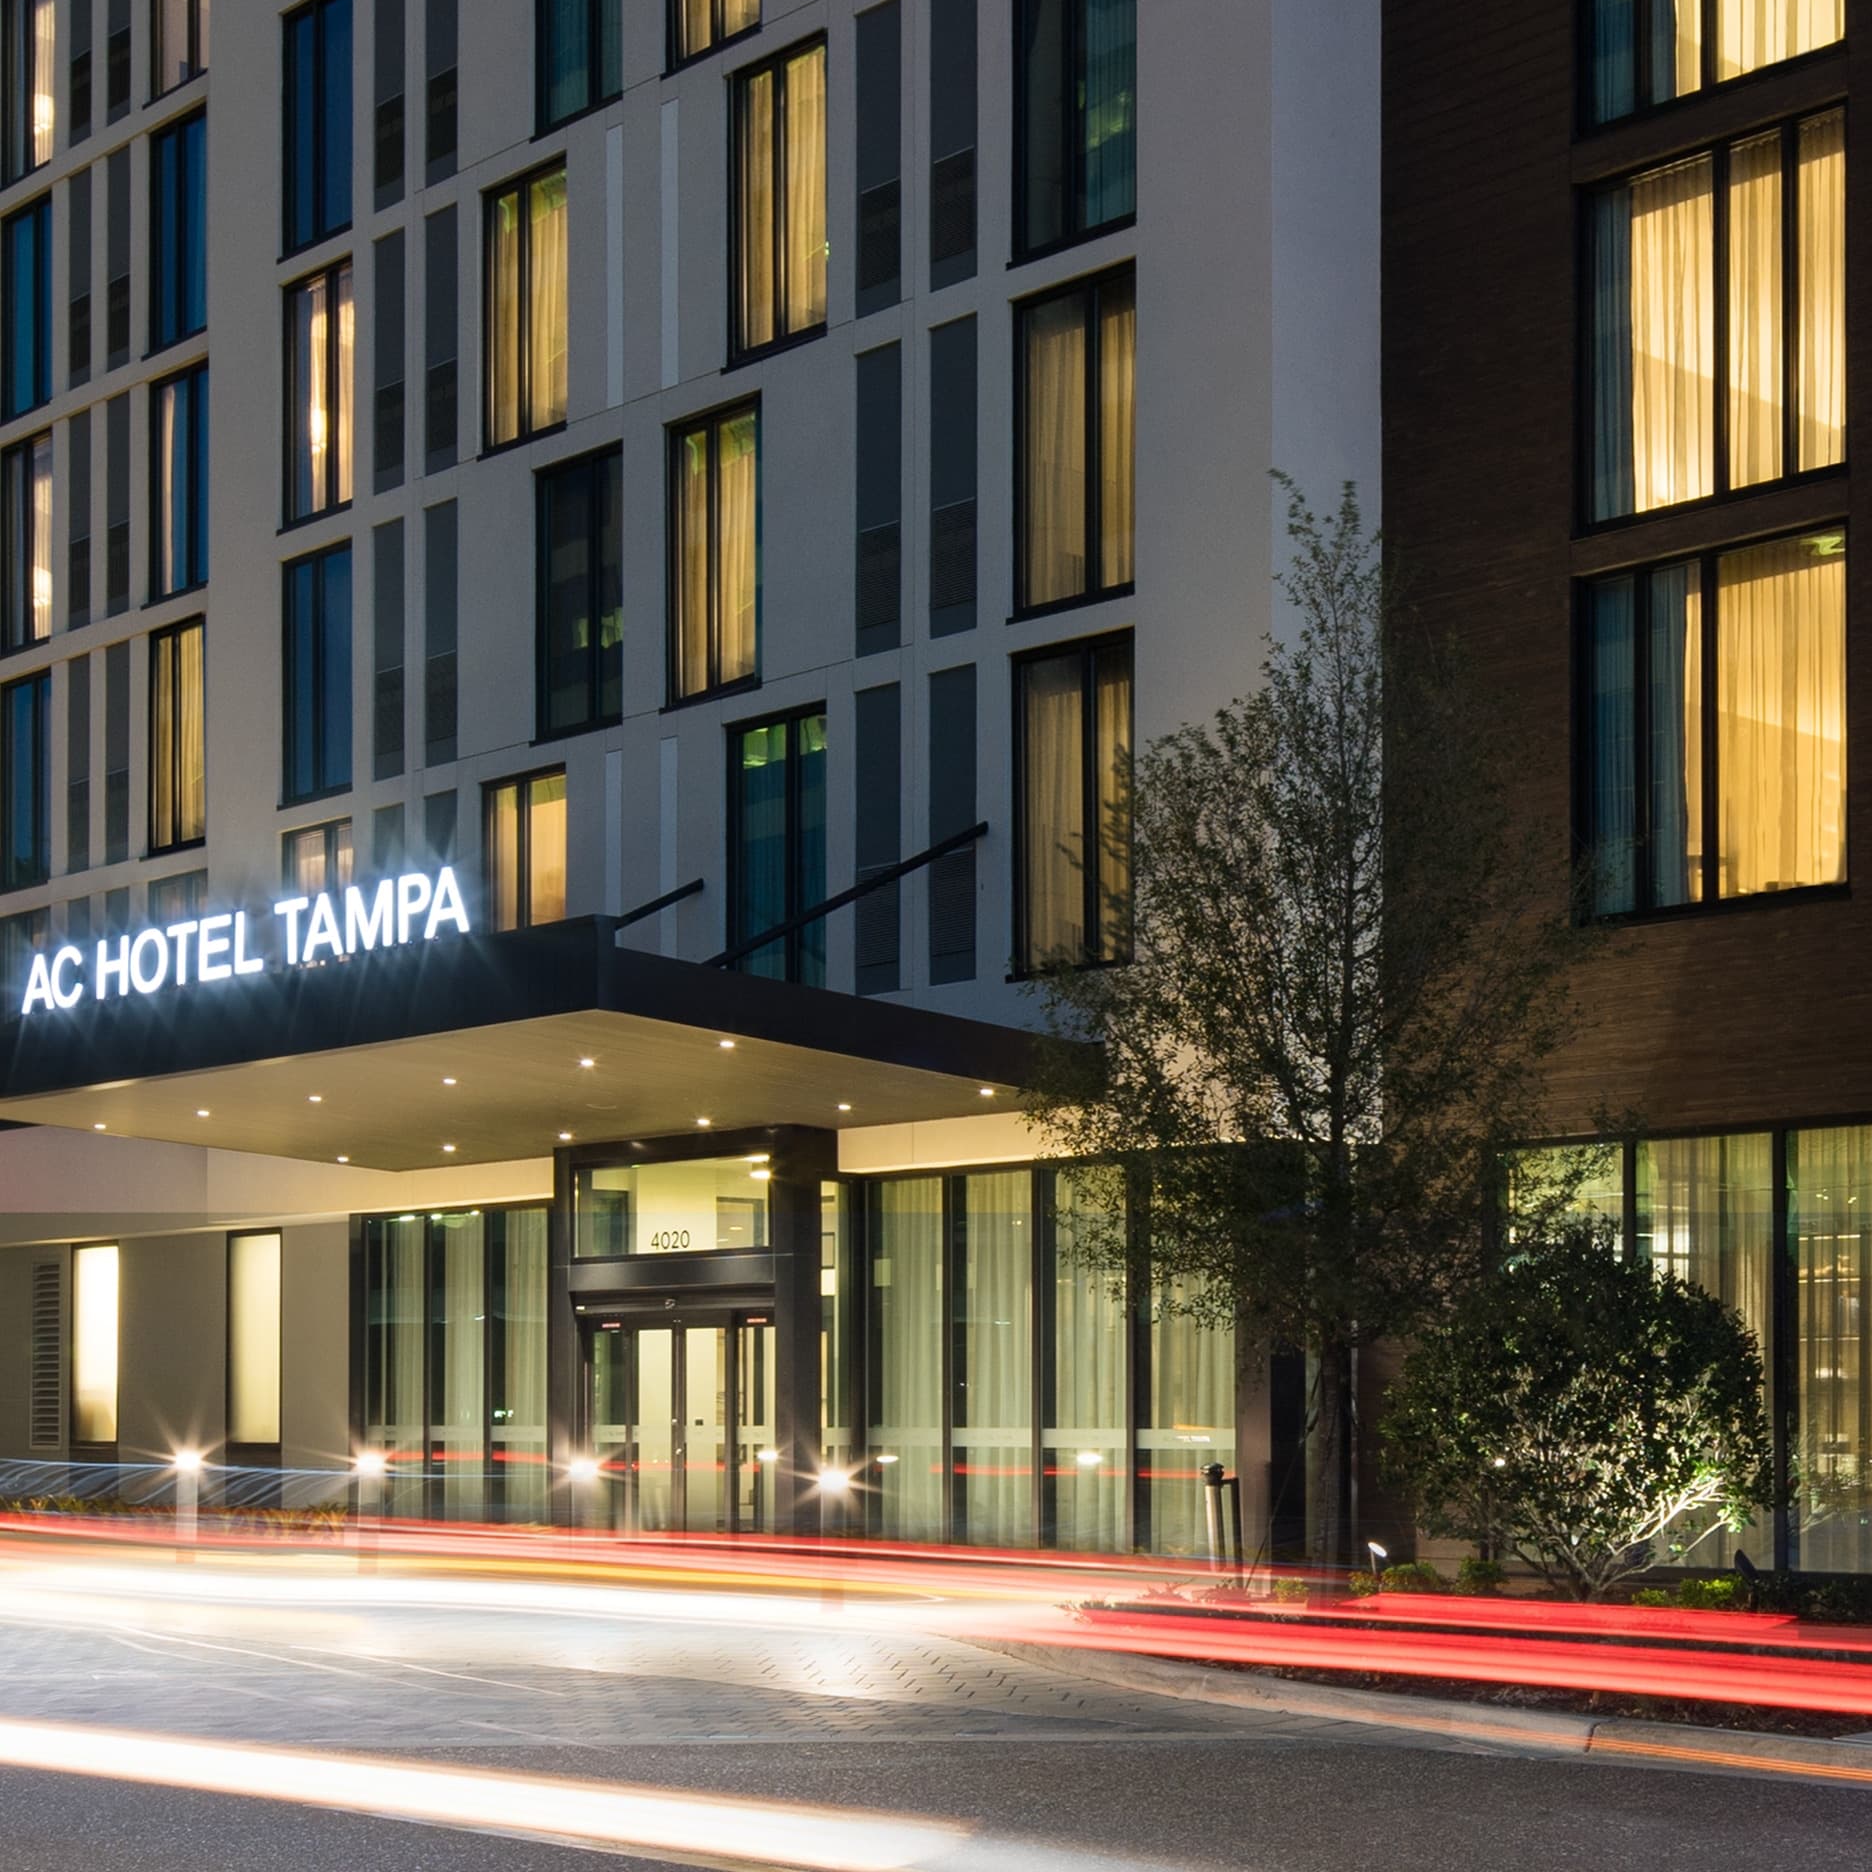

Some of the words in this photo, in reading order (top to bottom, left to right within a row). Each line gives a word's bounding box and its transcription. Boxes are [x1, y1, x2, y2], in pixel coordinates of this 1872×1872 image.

[20, 940, 84, 1016] AC
[95, 909, 265, 1001] HOTEL
[273, 865, 471, 966] TAMPA
[650, 1229, 691, 1250] 4020
